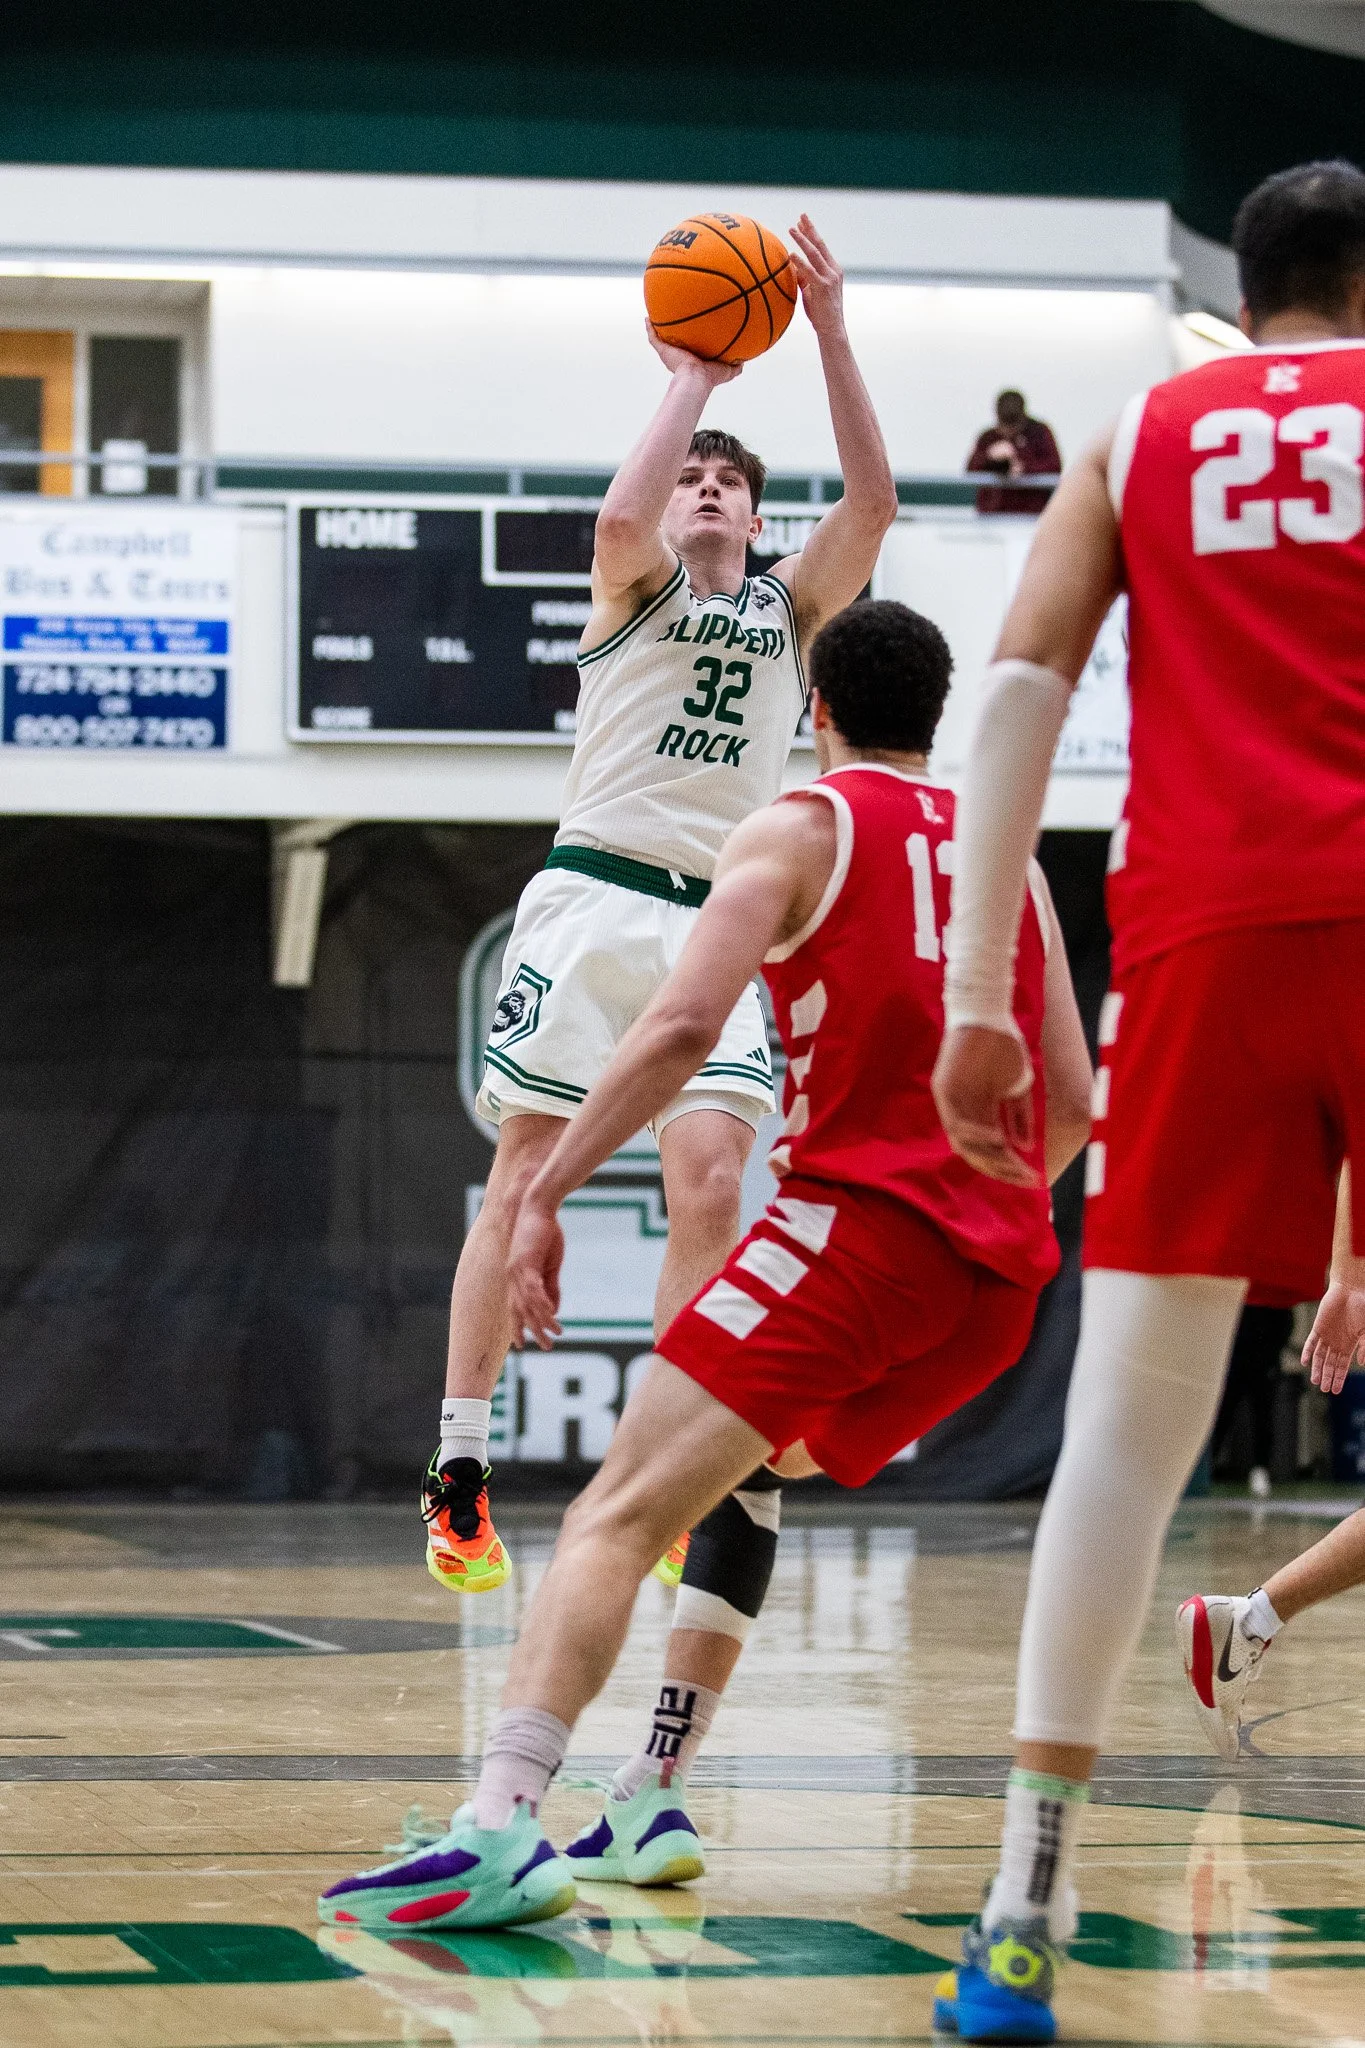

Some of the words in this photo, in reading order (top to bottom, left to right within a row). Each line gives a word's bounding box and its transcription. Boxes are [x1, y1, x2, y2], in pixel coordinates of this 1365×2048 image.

[1190, 402, 1364, 557] 23
[315, 510, 419, 550] HOME
[683, 655, 753, 726] 32
[656, 723, 750, 768] ROCK
